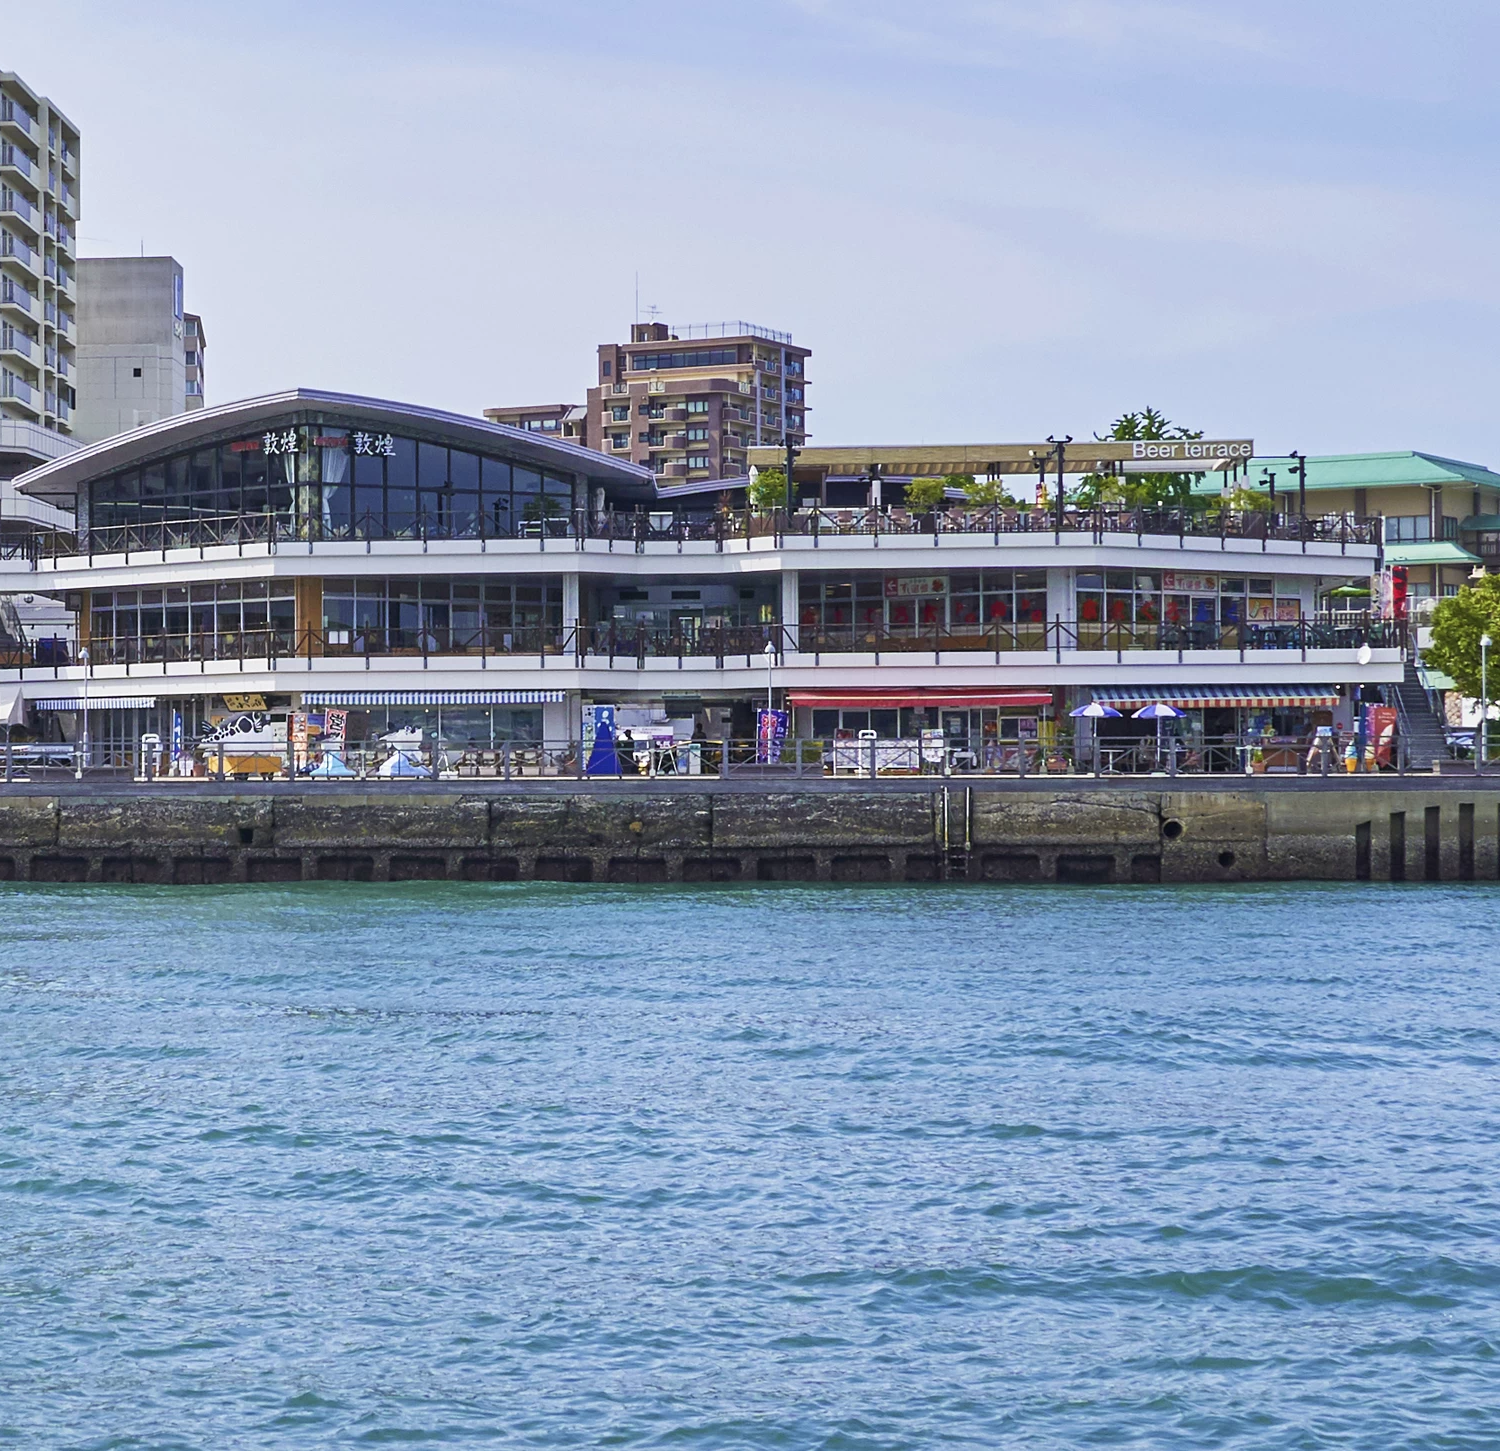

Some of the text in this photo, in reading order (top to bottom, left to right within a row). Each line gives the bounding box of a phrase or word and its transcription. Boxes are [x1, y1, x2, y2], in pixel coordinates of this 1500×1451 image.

[262, 427, 299, 455] 敦煌
[353, 432, 397, 456] 敦煌
[1132, 441, 1251, 458] Beer terrace
